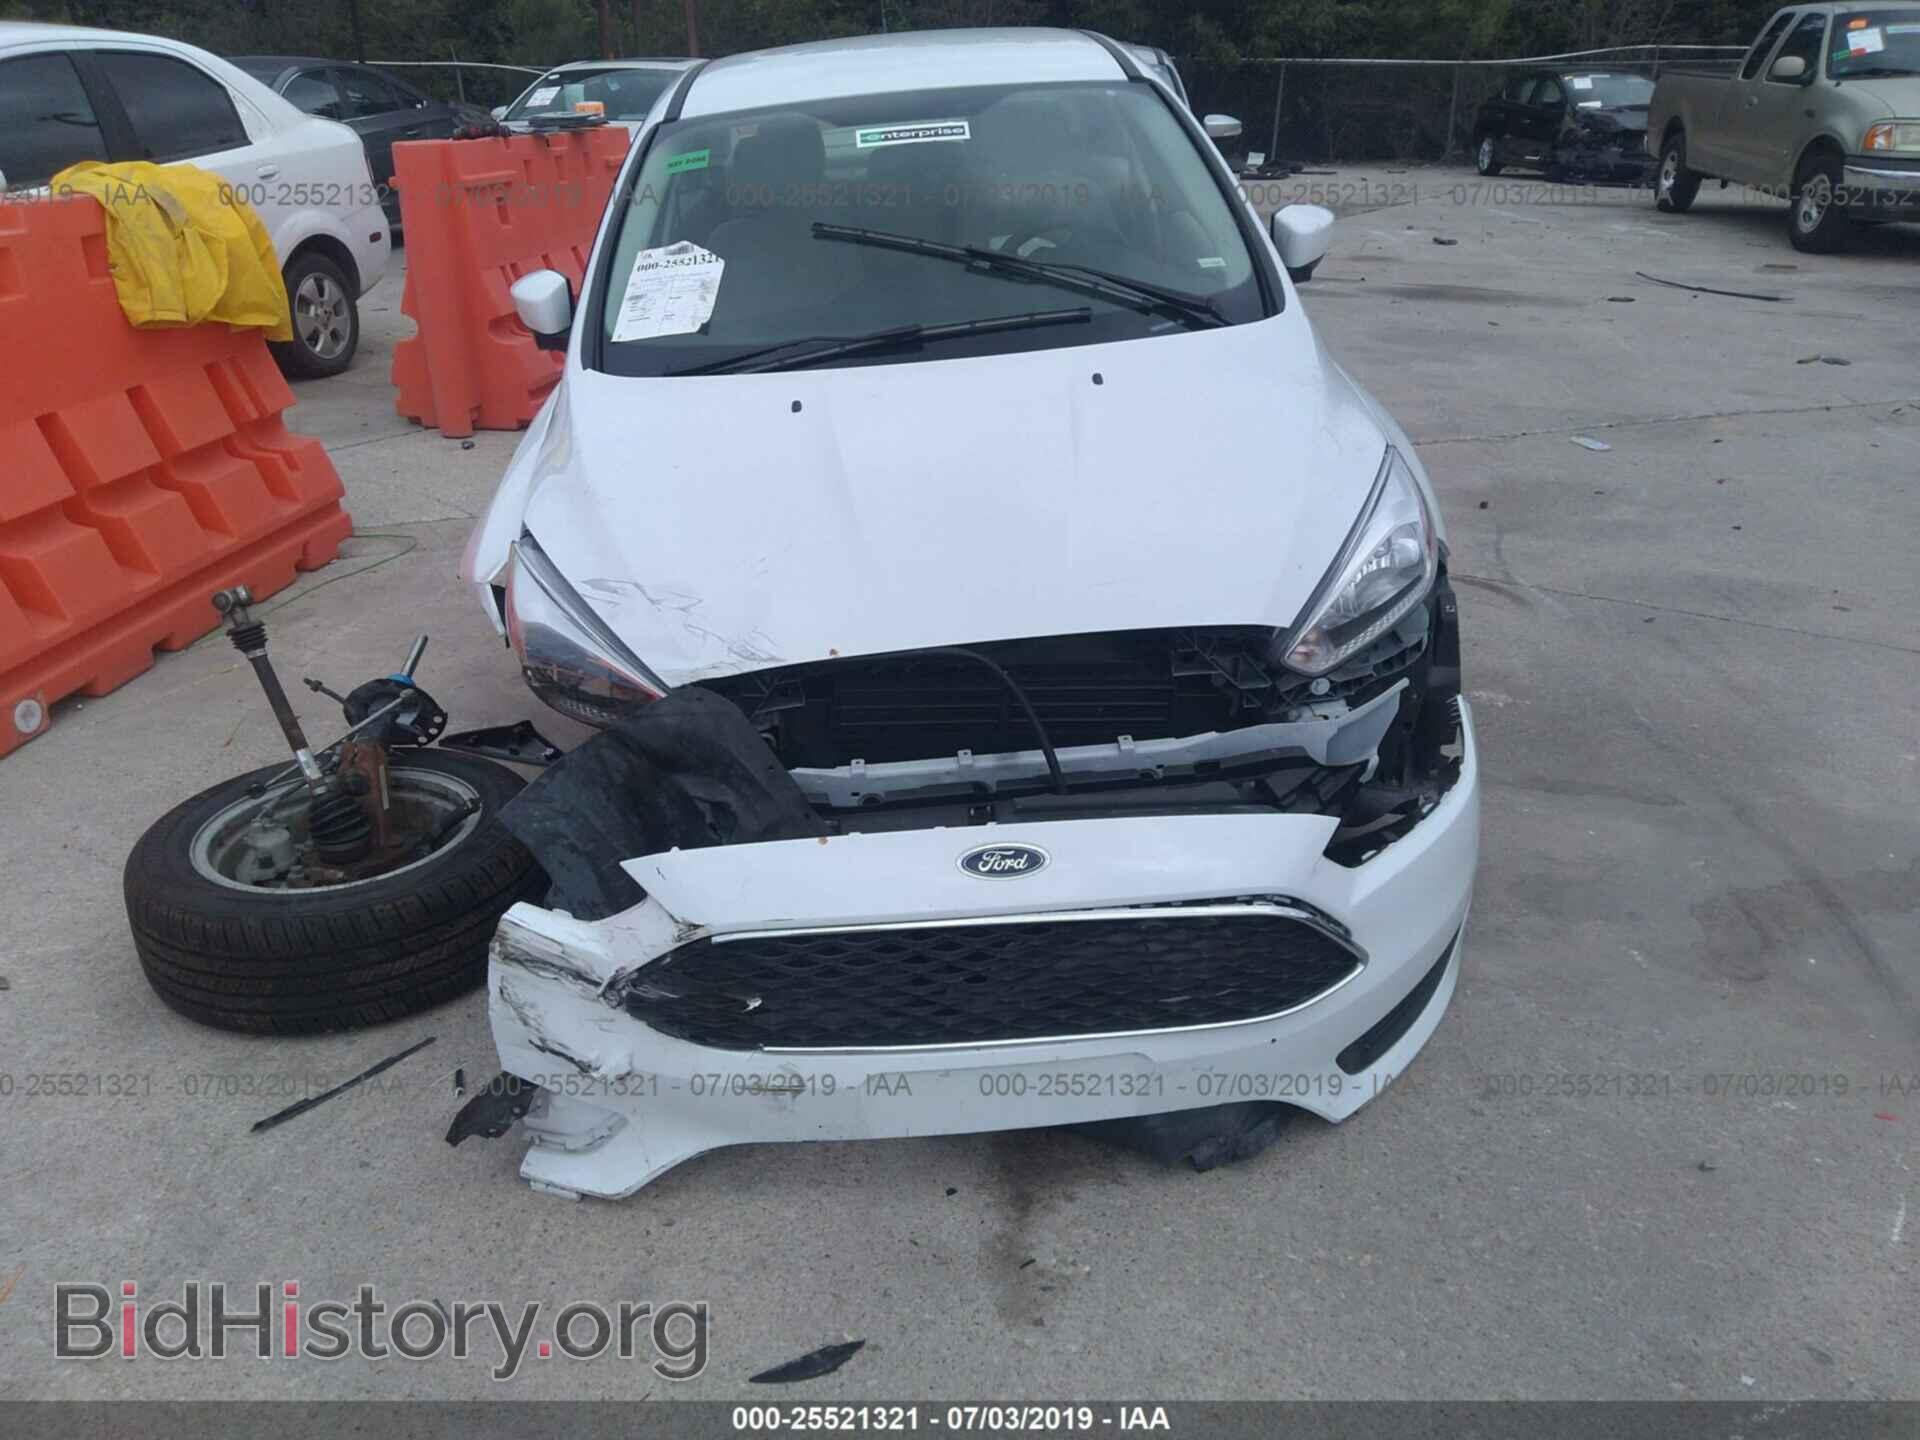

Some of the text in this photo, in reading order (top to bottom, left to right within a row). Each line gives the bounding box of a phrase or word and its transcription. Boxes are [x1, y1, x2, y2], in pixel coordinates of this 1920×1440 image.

[862, 127, 965, 141] enterprise
[636, 253, 719, 272] 000-25521321
[978, 850, 1029, 872] Ford
